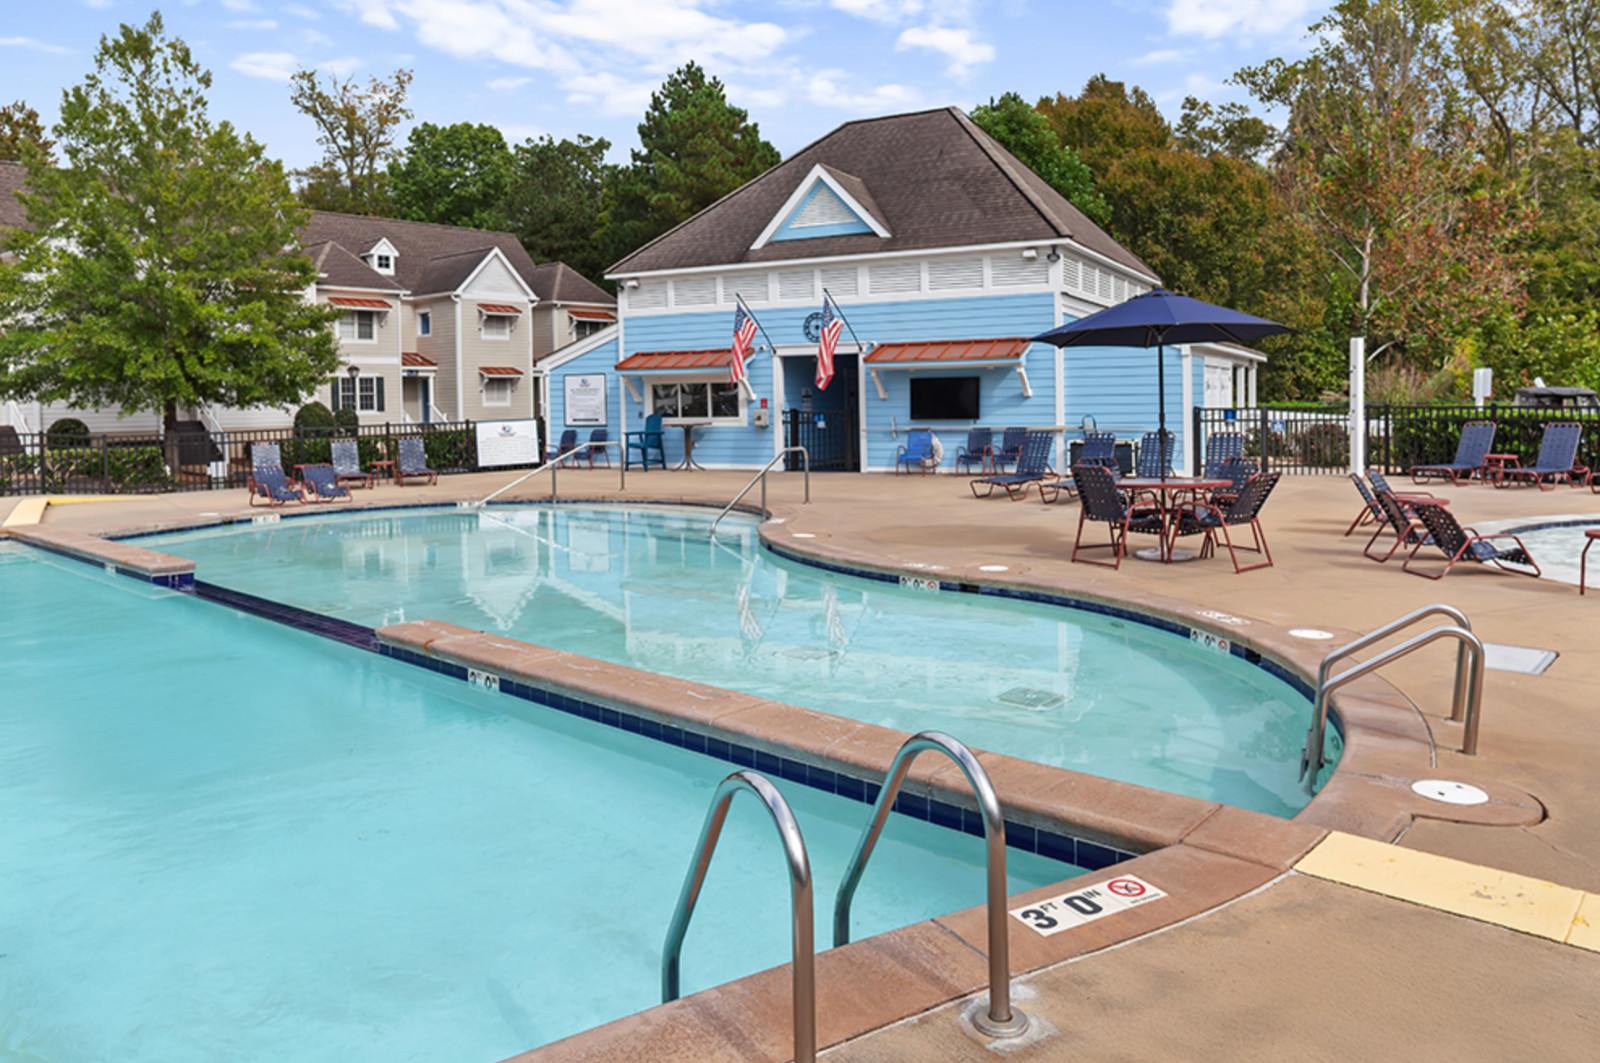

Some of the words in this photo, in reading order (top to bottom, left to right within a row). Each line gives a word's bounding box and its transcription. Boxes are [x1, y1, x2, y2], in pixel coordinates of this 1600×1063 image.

[1083, 889, 1102, 900] IN
[1039, 902, 1058, 914] FT
[1063, 895, 1103, 915] 0
[1021, 909, 1058, 929] 3
